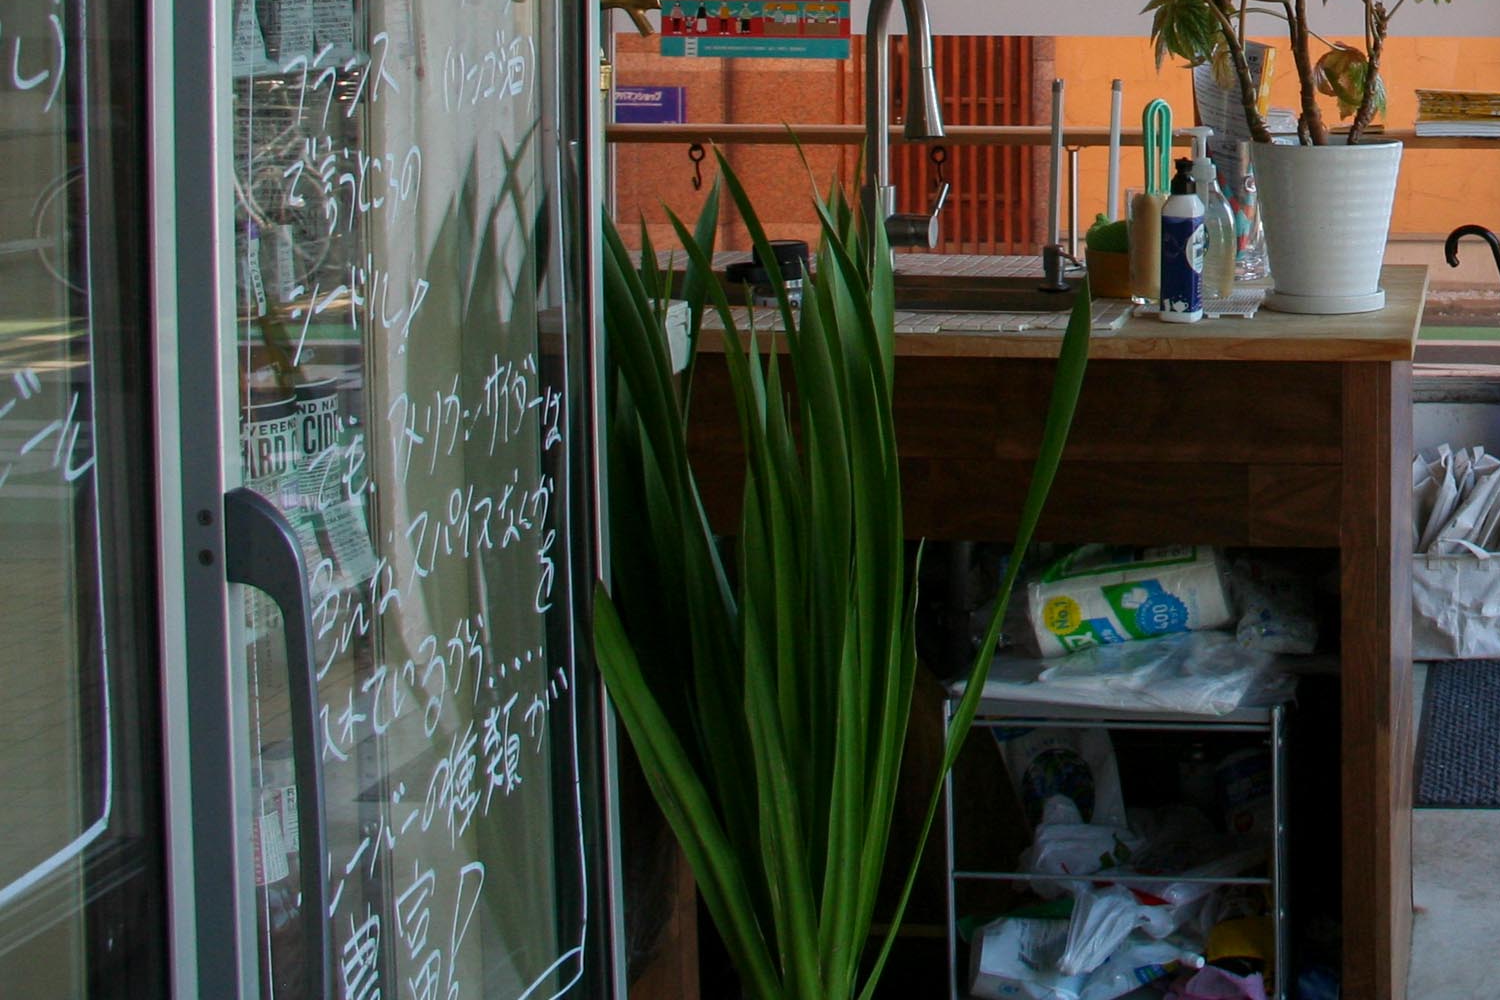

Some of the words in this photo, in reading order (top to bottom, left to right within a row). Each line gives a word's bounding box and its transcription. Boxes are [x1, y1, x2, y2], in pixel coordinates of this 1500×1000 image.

[281, 31, 398, 131] フランス
[1053, 600, 1069, 630] No.1
